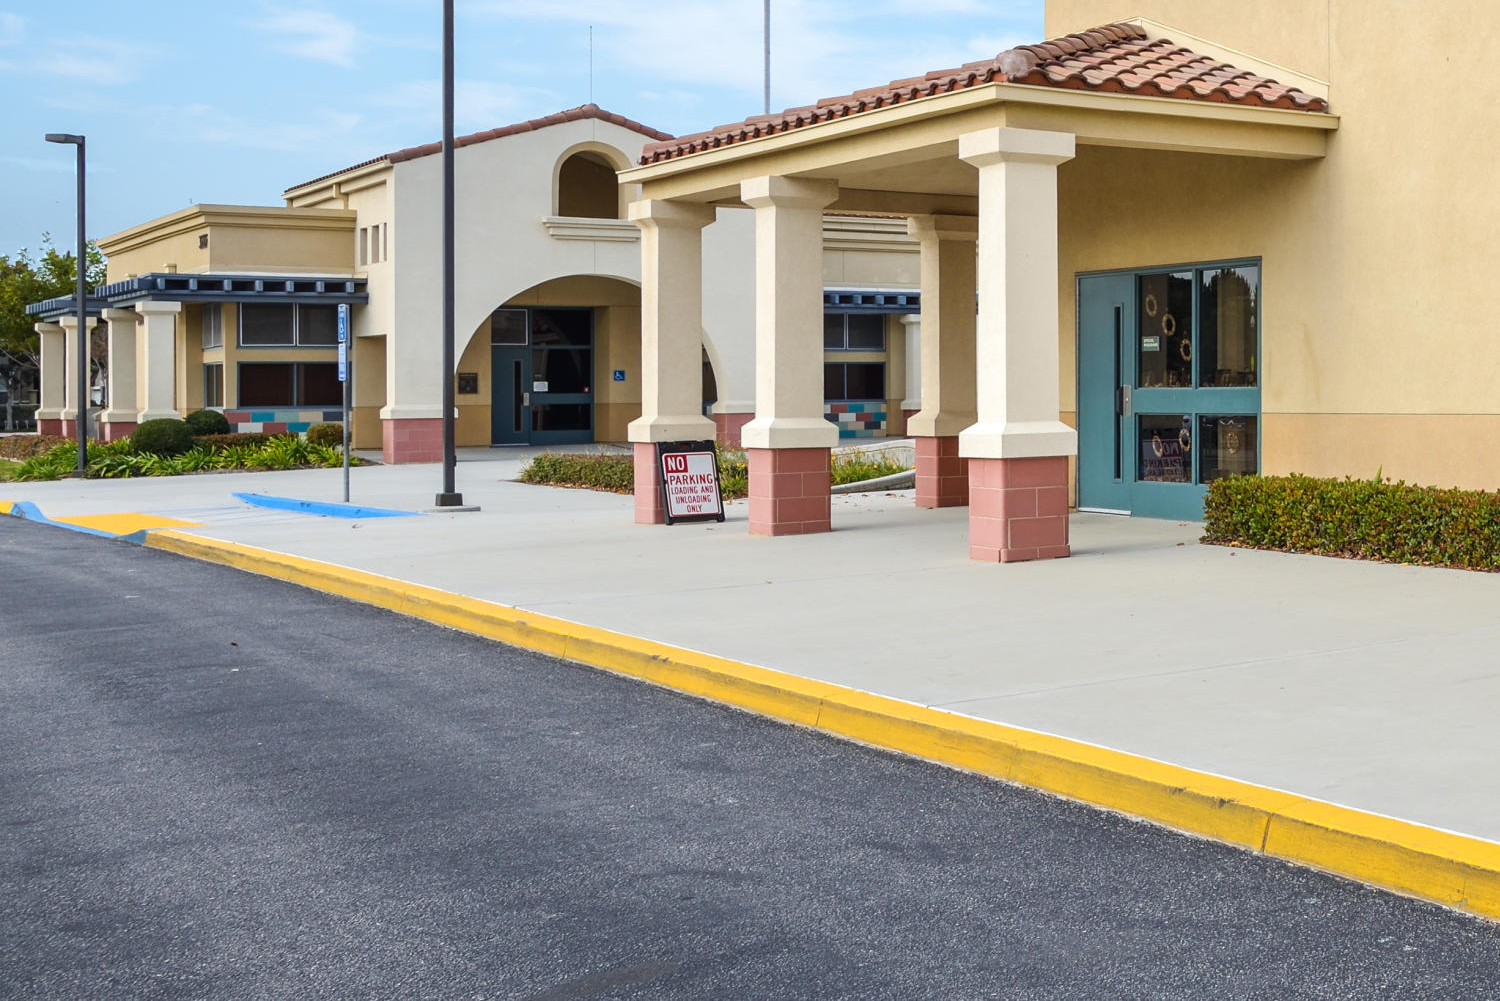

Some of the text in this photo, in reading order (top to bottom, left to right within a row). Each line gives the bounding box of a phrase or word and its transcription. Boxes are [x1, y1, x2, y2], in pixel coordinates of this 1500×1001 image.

[667, 456, 685, 471] NO
[669, 474, 713, 485] PARKING
[671, 485, 713, 495] LOADING AND
[676, 495, 711, 504] UNLOADING
[687, 504, 702, 513] ONLY
